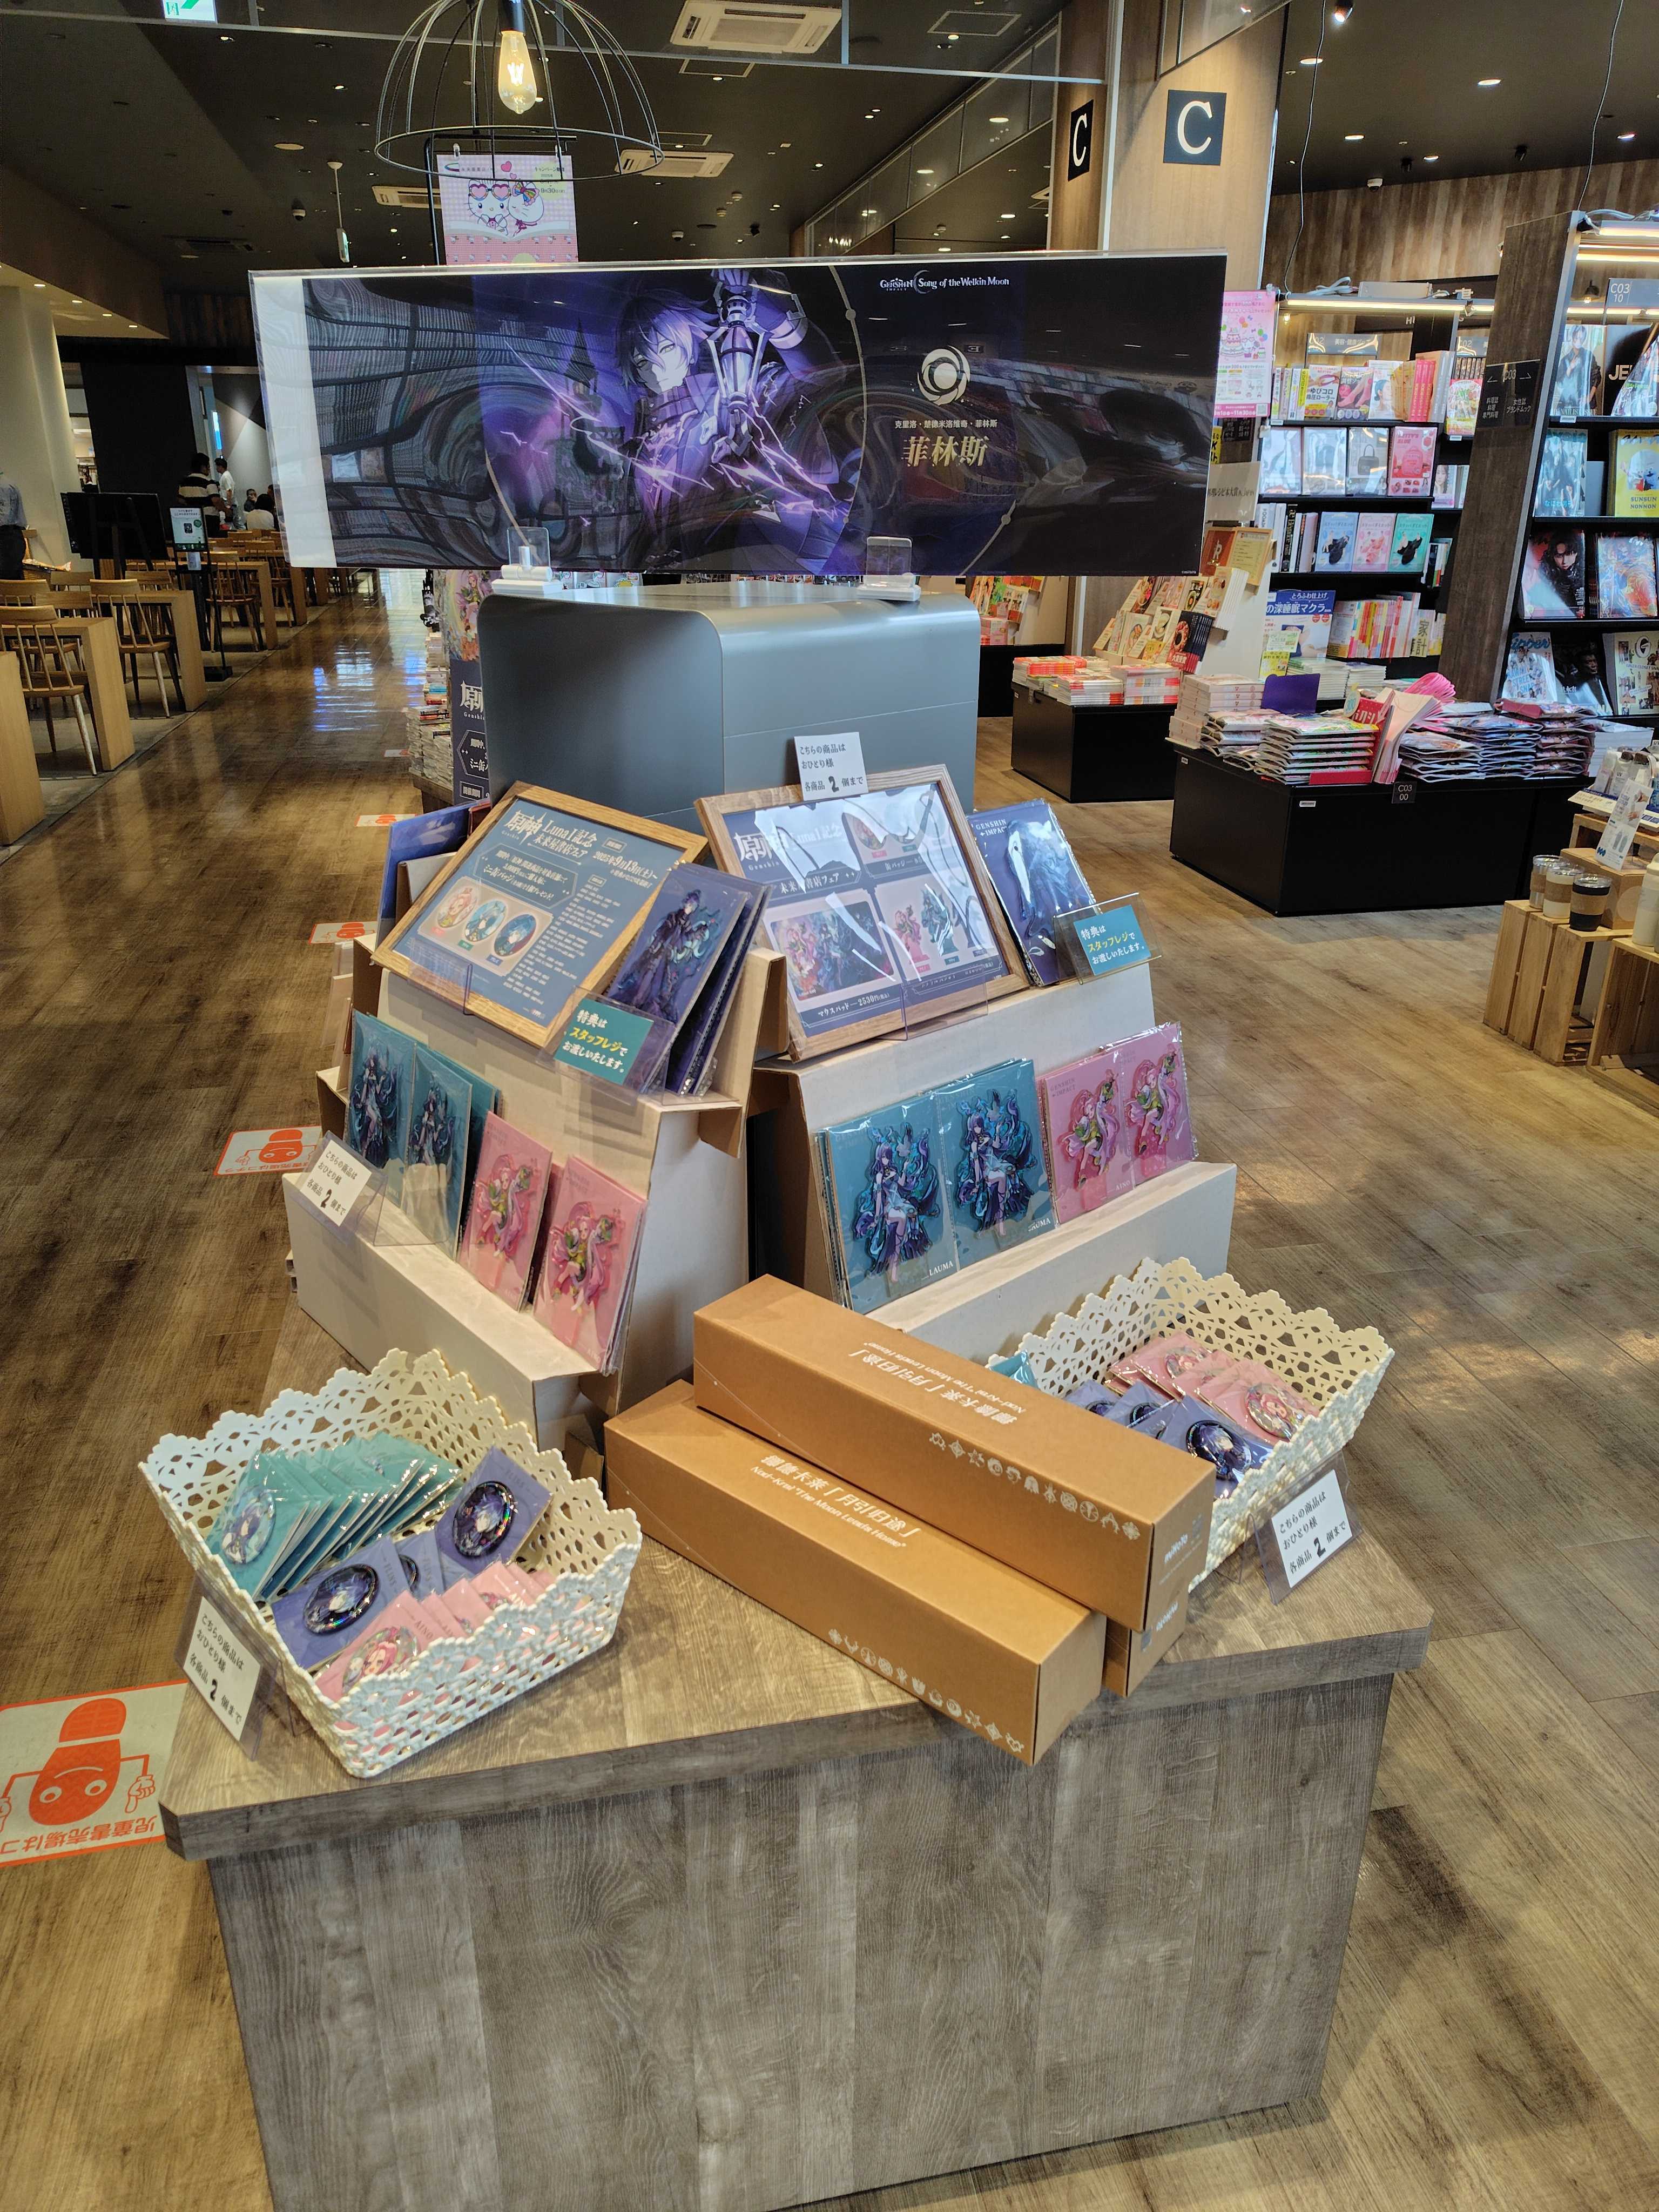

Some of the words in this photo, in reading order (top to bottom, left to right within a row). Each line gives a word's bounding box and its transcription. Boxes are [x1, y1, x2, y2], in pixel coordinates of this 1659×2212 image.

[1177, 100, 1212, 154] C
[1073, 113, 1087, 167] C
[880, 278, 913, 288] GENSHIN
[918, 278, 938, 289] Song
[939, 278, 948, 288] of
[948, 278, 961, 286] the
[961, 277, 986, 286] Welkin
[988, 276, 1010, 286] Moon
[1611, 283, 1630, 294] C03
[1614, 294, 1623, 302] 10
[1608, 365, 1633, 380] JE
[901, 436, 990, 467] 菲林斯
[1415, 619, 1430, 656] 家計
[800, 743, 846, 755] こちらの商品は
[801, 758, 834, 769] おひとり様
[805, 780, 825, 792] 各商品
[828, 775, 839, 793] 2
[842, 777, 864, 787] 個まで
[976, 819, 1007, 831] GENSHIN
[533, 834, 588, 858] 未来屋書店フェア
[1081, 925, 1107, 940] 特典は
[1088, 932, 1135, 953] スタッフレジで
[1092, 942, 1144, 965] お渡しいたします。
[577, 1009, 608, 1028] 特典は
[570, 1027, 628, 1056] スタッフレジで
[562, 1041, 624, 1073] お渡しいたします。
[318, 1162, 342, 1185] おひとり様
[326, 1150, 358, 1180] こちらの商品は
[307, 1178, 323, 1196] 各商品
[320, 1189, 332, 1208] 2
[330, 1199, 347, 1216] 個まで
[929, 1261, 954, 1277] LAUMA
[924, 1366, 955, 1381] Moon
[751, 1466, 796, 1492] Nod-Krai
[814, 1499, 842, 1517] Moon
[841, 1512, 873, 1534] Leads
[1279, 1492, 1326, 1534] こちらの商品は
[1283, 1516, 1318, 1550] おひとり様
[1289, 1549, 1312, 1574] 各商品
[1313, 1537, 1326, 1557] 2
[1326, 1521, 1346, 1543] 個まで
[414, 1620, 434, 1640] AINO
[197, 1629, 226, 1674] おひとり様
[202, 1614, 245, 1671] こちらの商品は
[190, 1653, 208, 1685] 各商品
[210, 1679, 218, 1702] 2
[221, 1695, 242, 1724] 個まで
